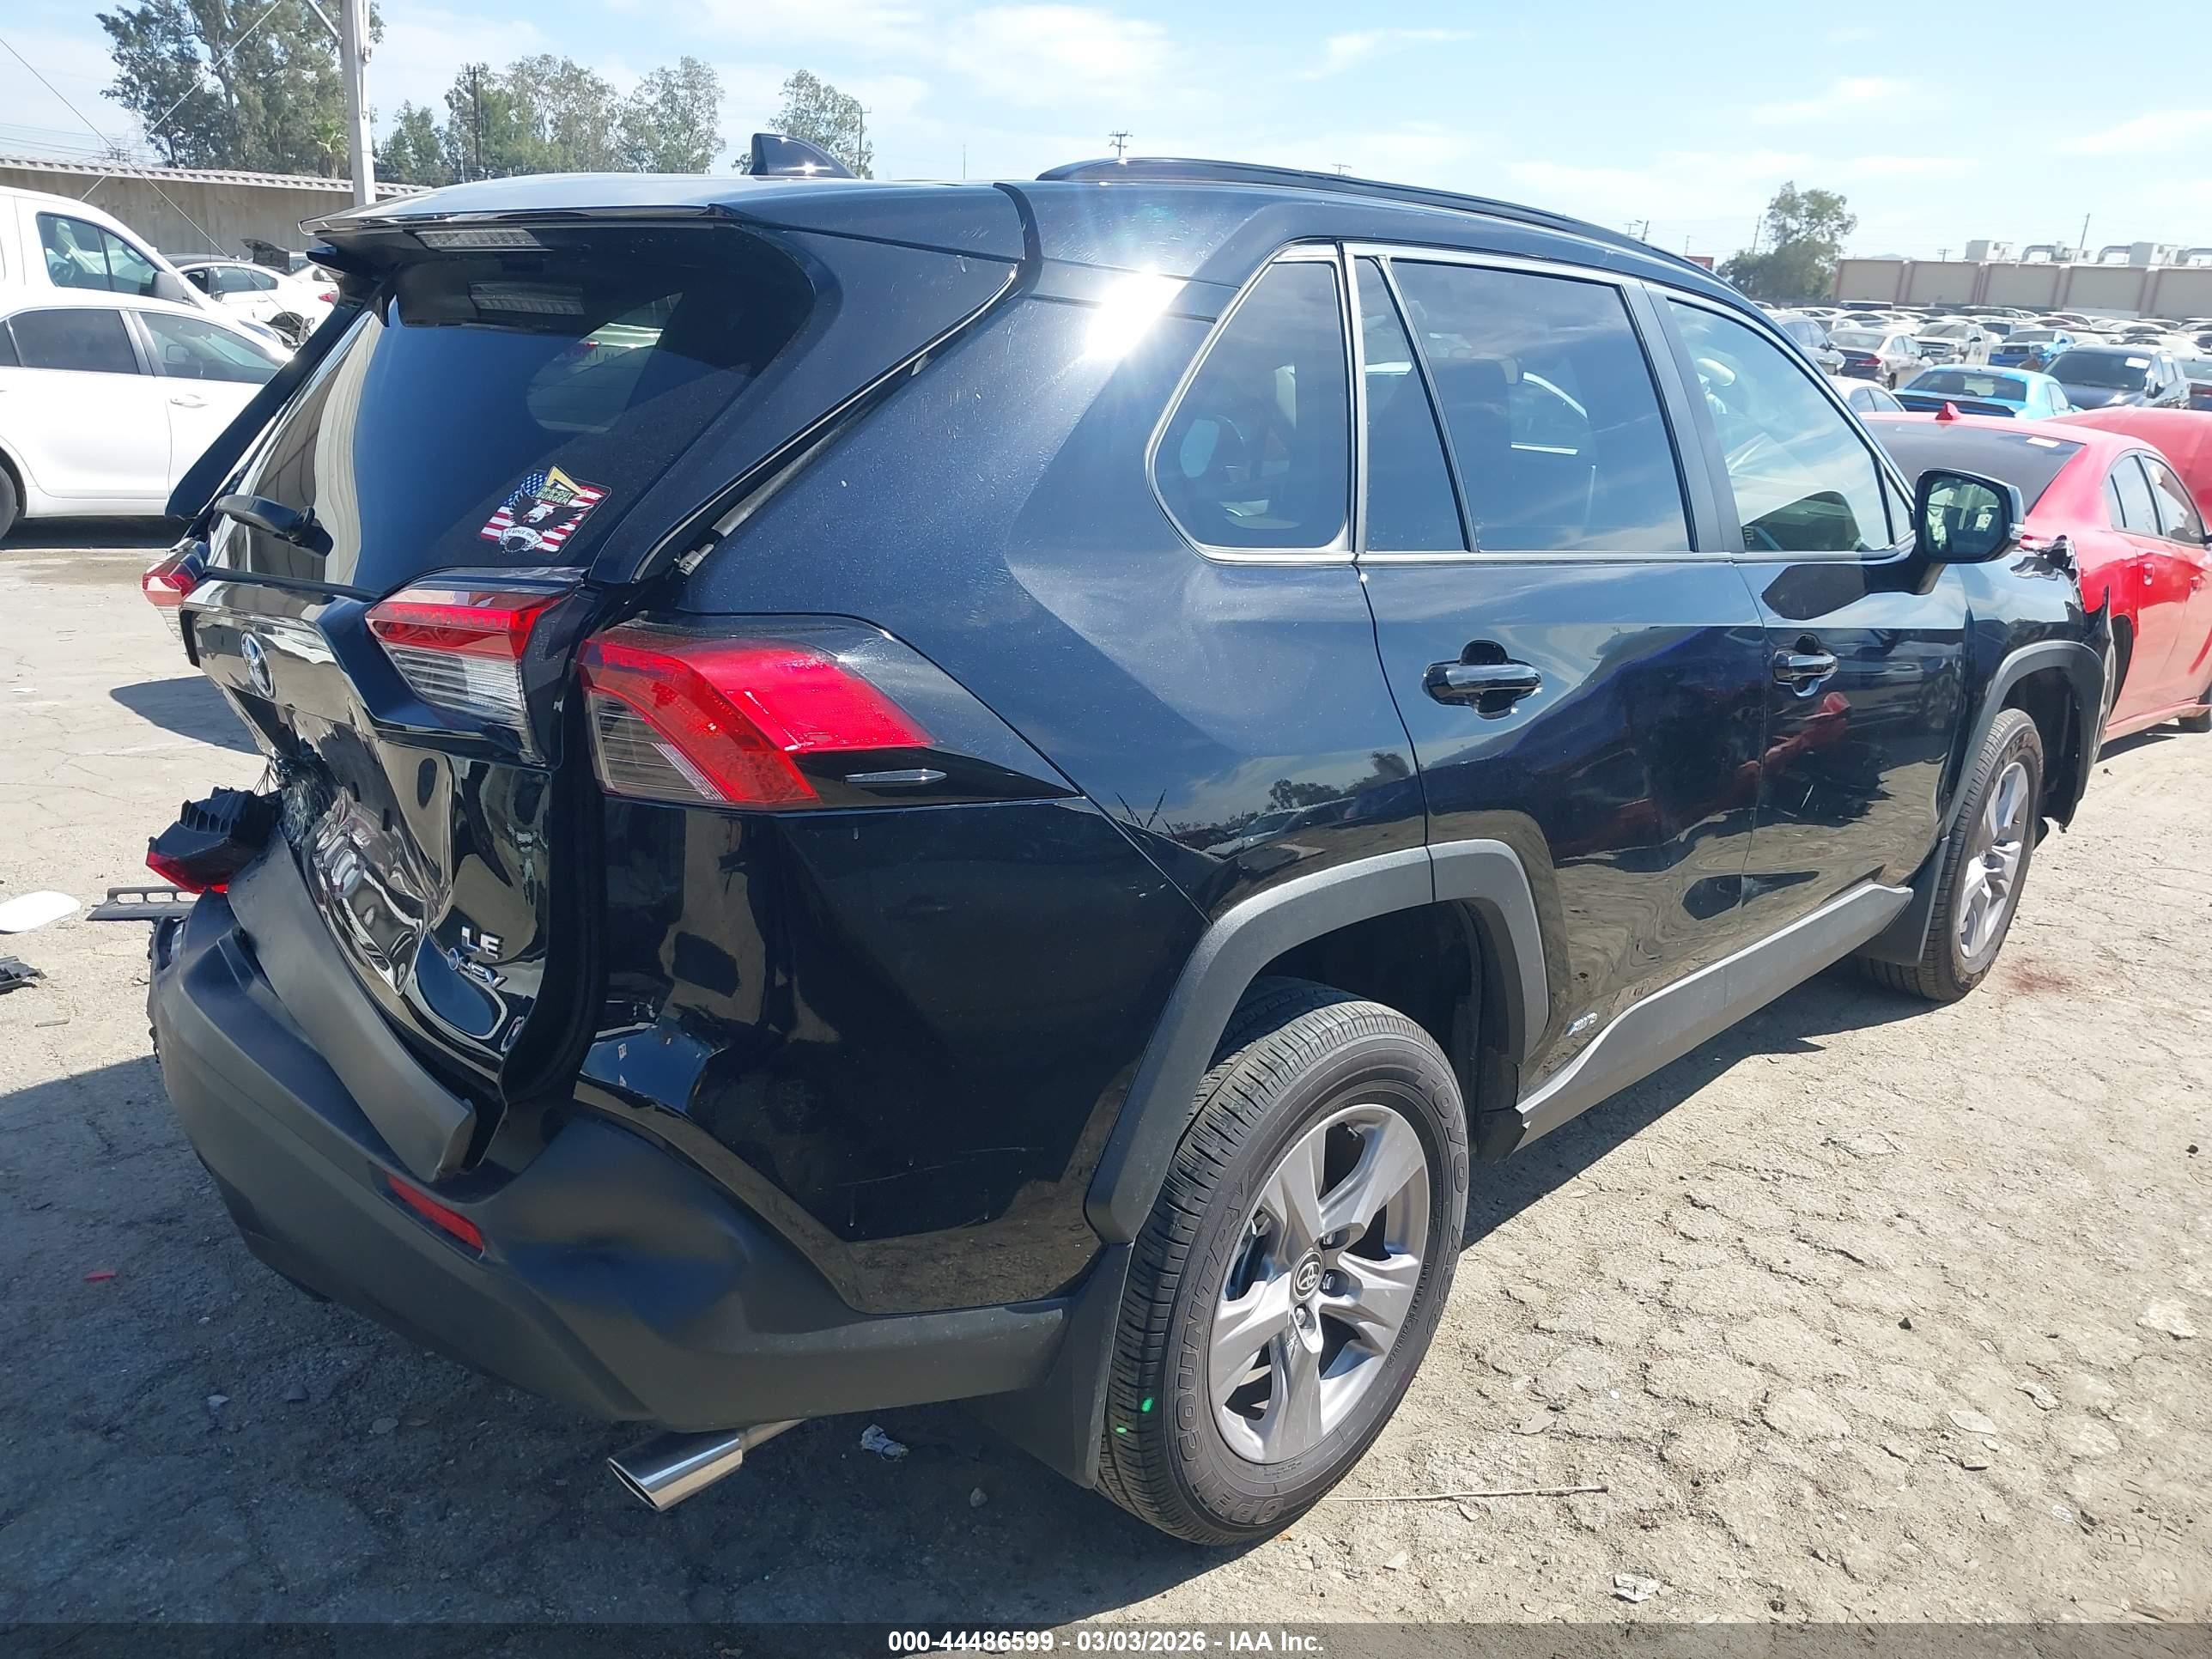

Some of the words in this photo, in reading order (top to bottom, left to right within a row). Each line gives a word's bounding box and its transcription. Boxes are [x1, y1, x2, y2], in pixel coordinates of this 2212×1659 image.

[536, 493, 569, 505] BURGER
[540, 486, 576, 498] IN-N-OUT
[461, 926, 503, 960] LE
[1415, 1062, 1468, 1194] TOYO
[1176, 1170, 1250, 1462] COUNTRY
[1193, 1470, 1285, 1525] OPEN
